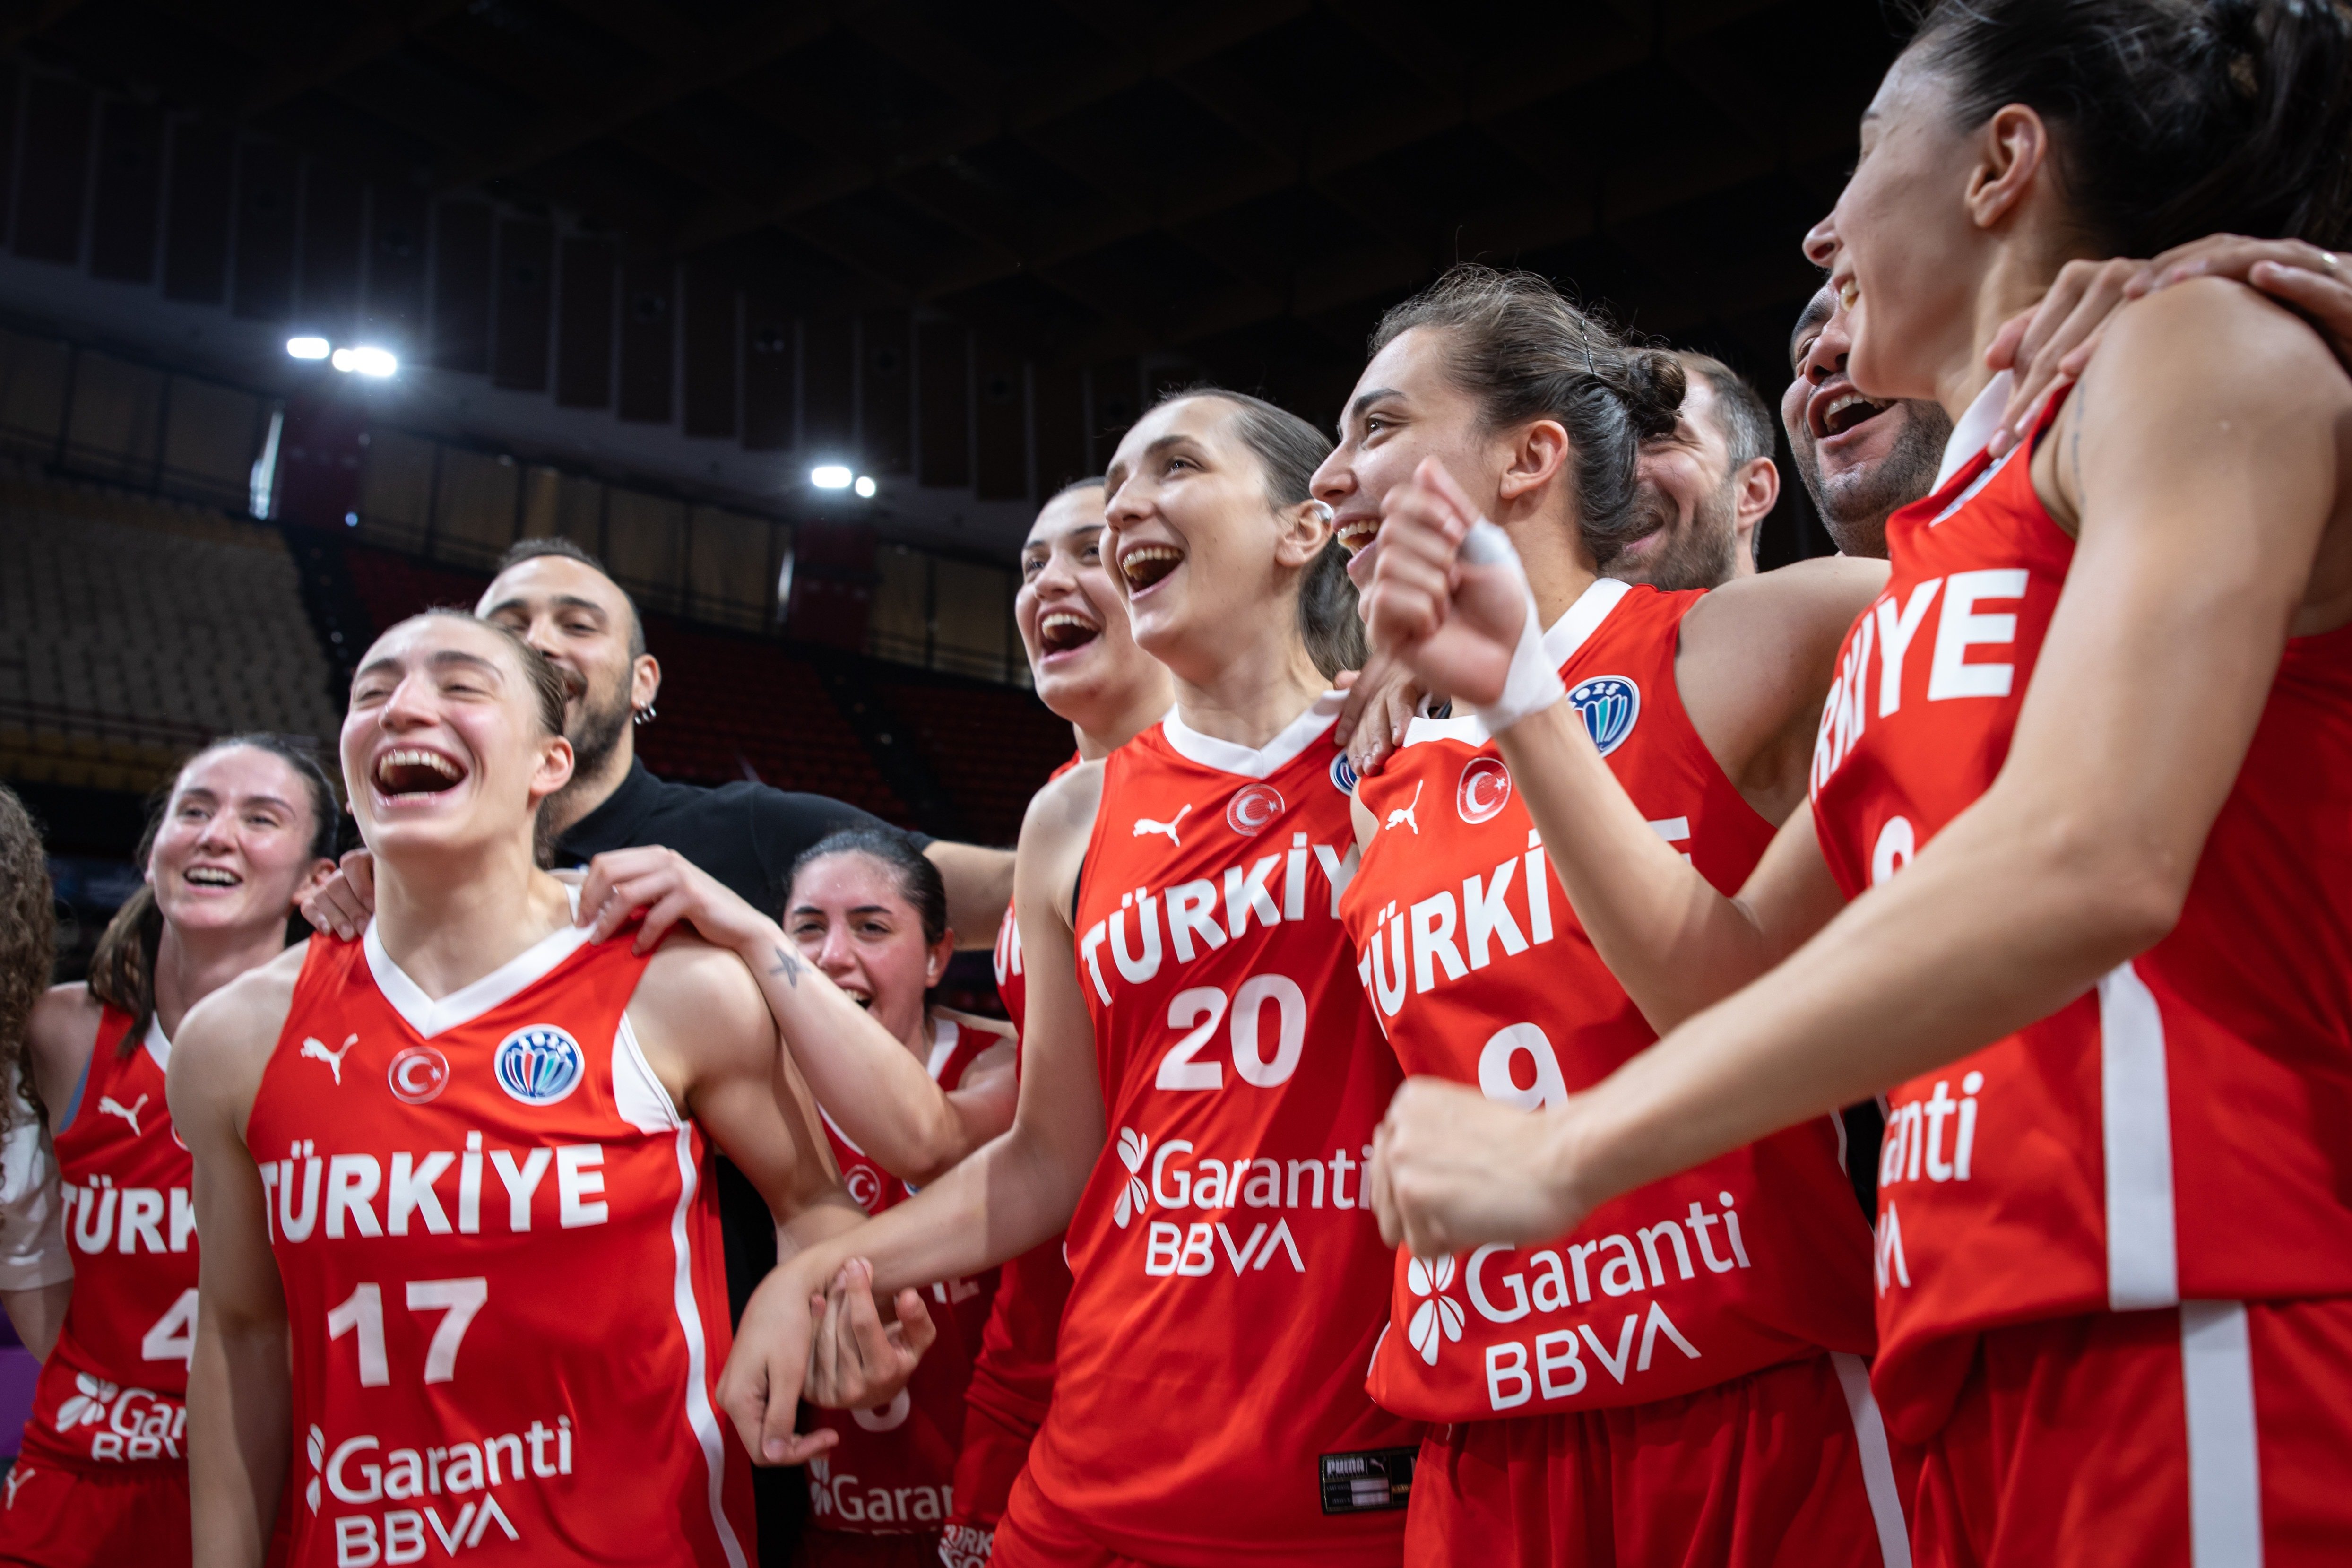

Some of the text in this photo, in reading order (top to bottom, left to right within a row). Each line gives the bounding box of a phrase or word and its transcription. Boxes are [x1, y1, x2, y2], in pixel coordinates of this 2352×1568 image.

[1358, 815, 1692, 1040] TÜRKİ
[1156, 973, 1307, 1091] 20
[1478, 1024, 1568, 1111] 9
[259, 1130, 608, 1244] TÜRKİYE
[1152, 1139, 1374, 1210] Garanti
[1145, 1217, 1306, 1277] BBVA
[1465, 1191, 1751, 1323] Garanti
[142, 1287, 199, 1372] 4
[328, 1276, 488, 1388] 17
[1486, 1300, 1701, 1411] BBVA
[326, 1414, 572, 1505] Garanti
[335, 1492, 519, 1568] BBVA
